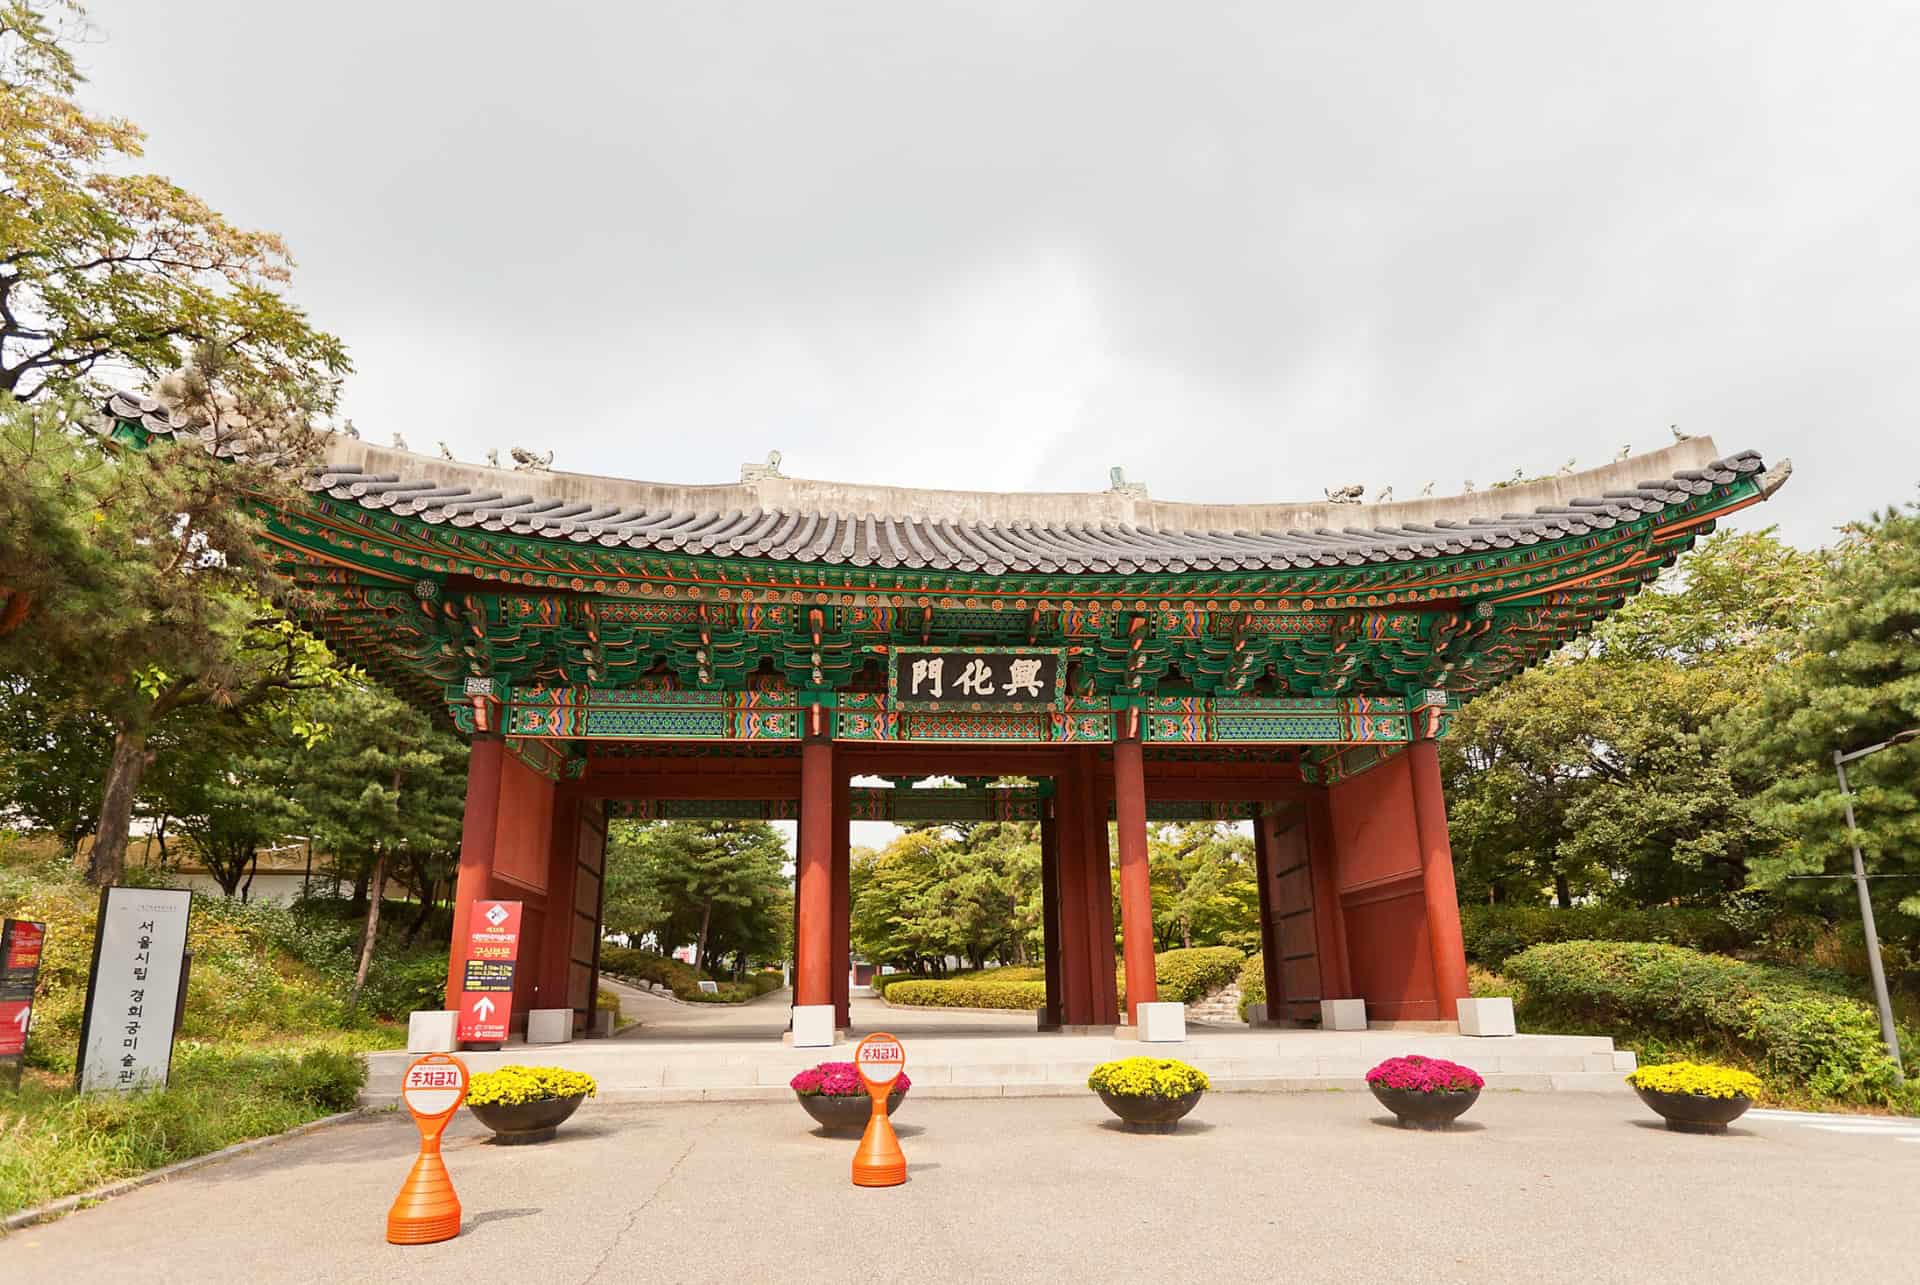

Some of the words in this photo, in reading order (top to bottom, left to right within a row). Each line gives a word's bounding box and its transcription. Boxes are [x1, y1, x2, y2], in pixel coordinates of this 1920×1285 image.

[133, 920, 154, 981] 서울시립
[863, 1047, 898, 1060] 주차금지
[411, 1072, 457, 1086] 주차금지
